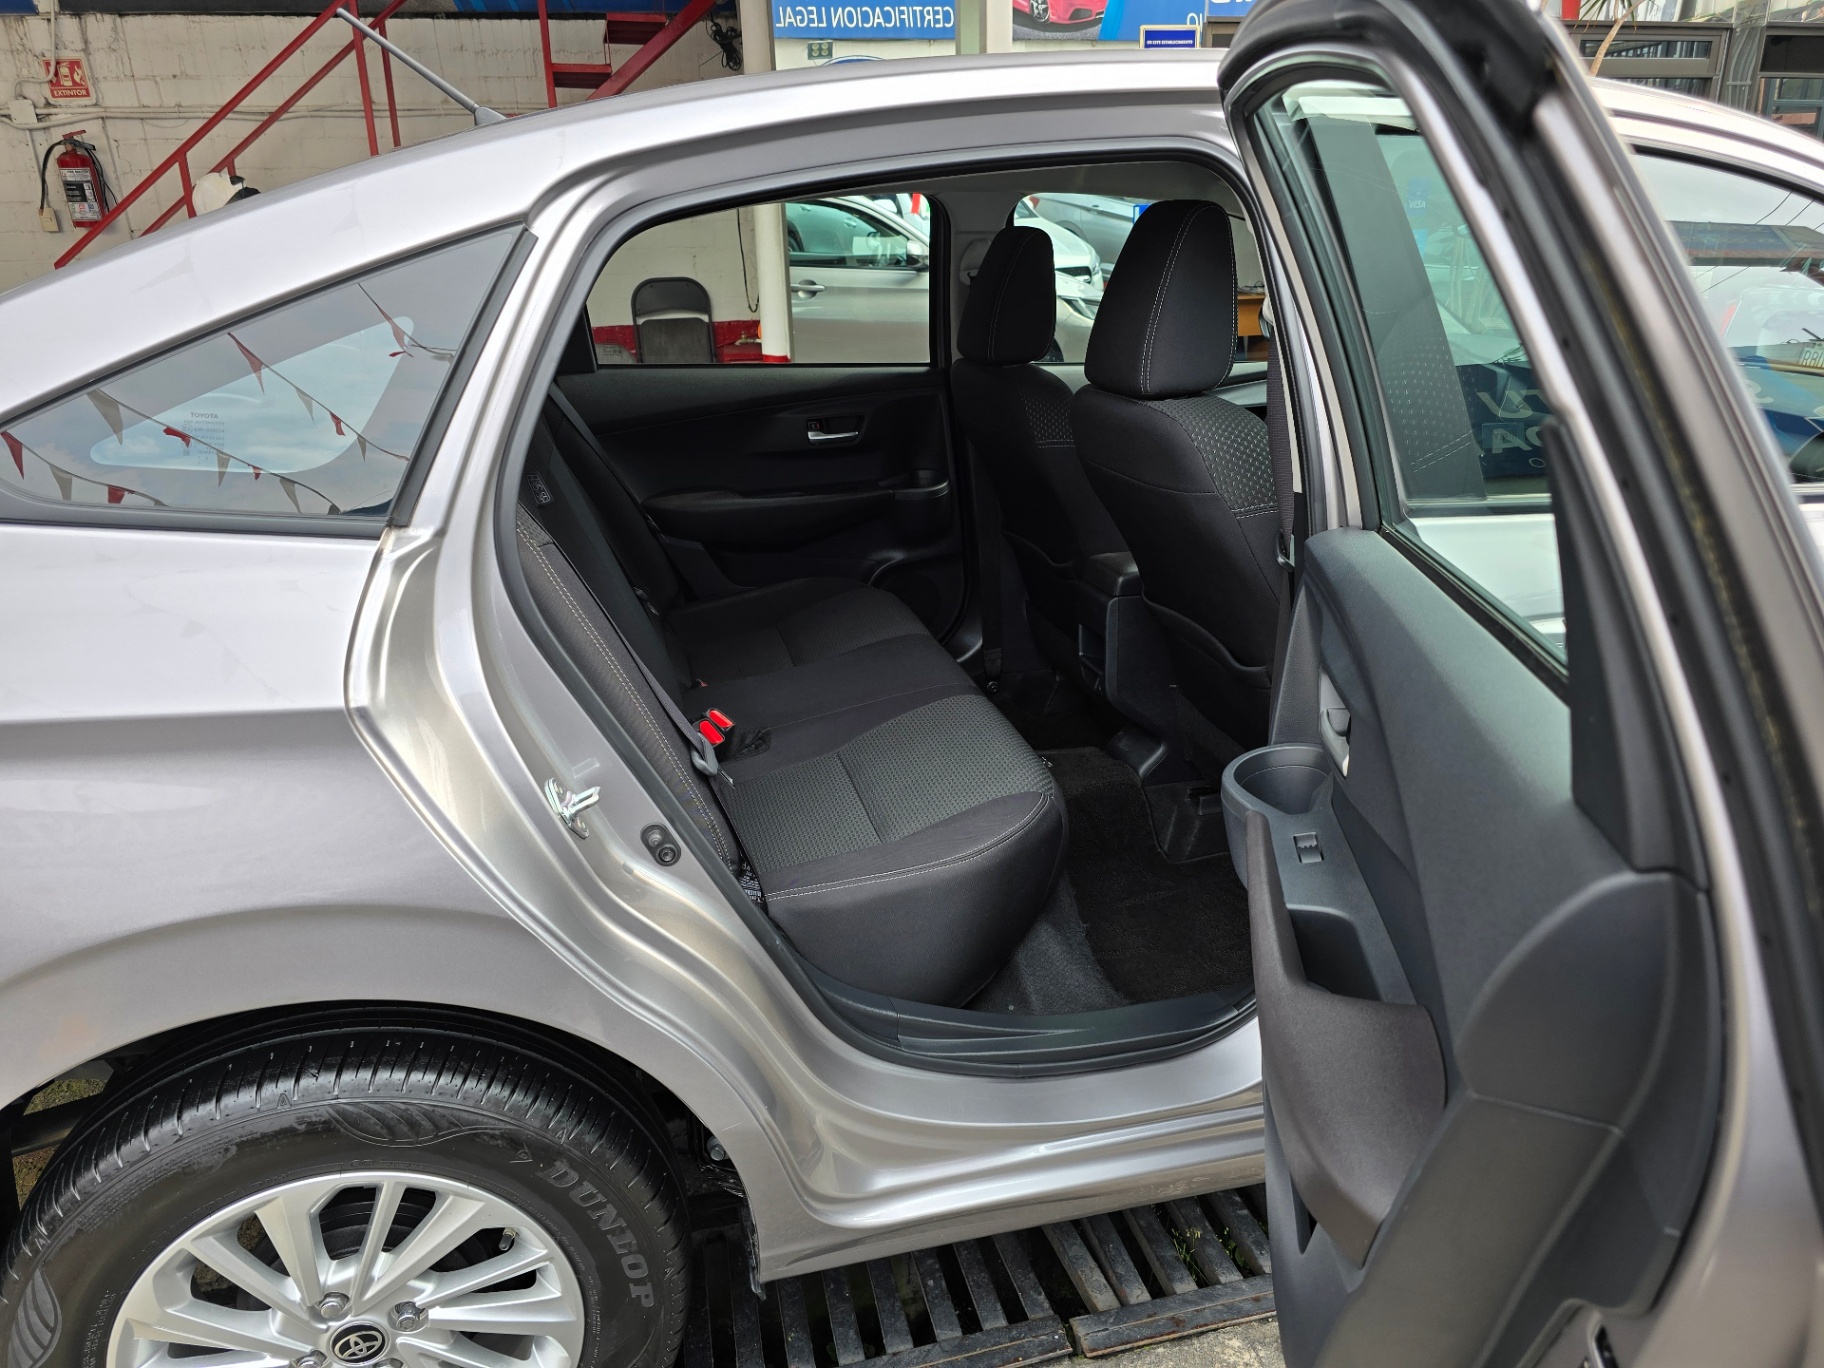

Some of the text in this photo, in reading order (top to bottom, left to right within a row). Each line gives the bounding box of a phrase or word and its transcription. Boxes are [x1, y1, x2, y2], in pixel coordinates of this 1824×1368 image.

[53, 89, 88, 97] EXTINTOR
[1408, 199, 1426, 209] VISA
[536, 1159, 655, 1308] DUNLOP
